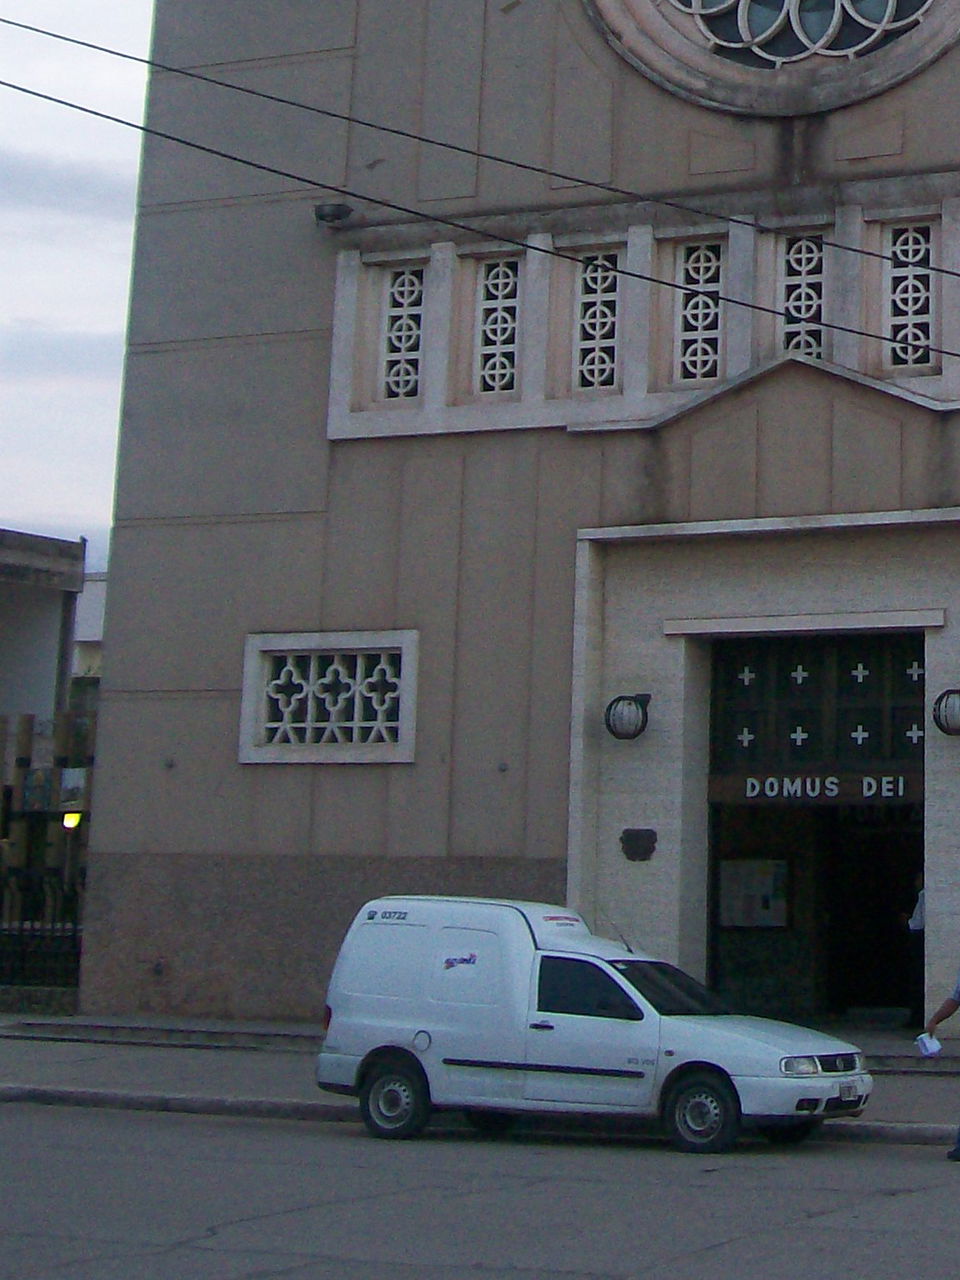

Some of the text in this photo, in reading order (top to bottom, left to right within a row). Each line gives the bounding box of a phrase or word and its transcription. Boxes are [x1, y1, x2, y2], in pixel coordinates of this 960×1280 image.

[745, 775, 905, 798] DOMUS DEI
[381, 911, 408, 921] 03722
